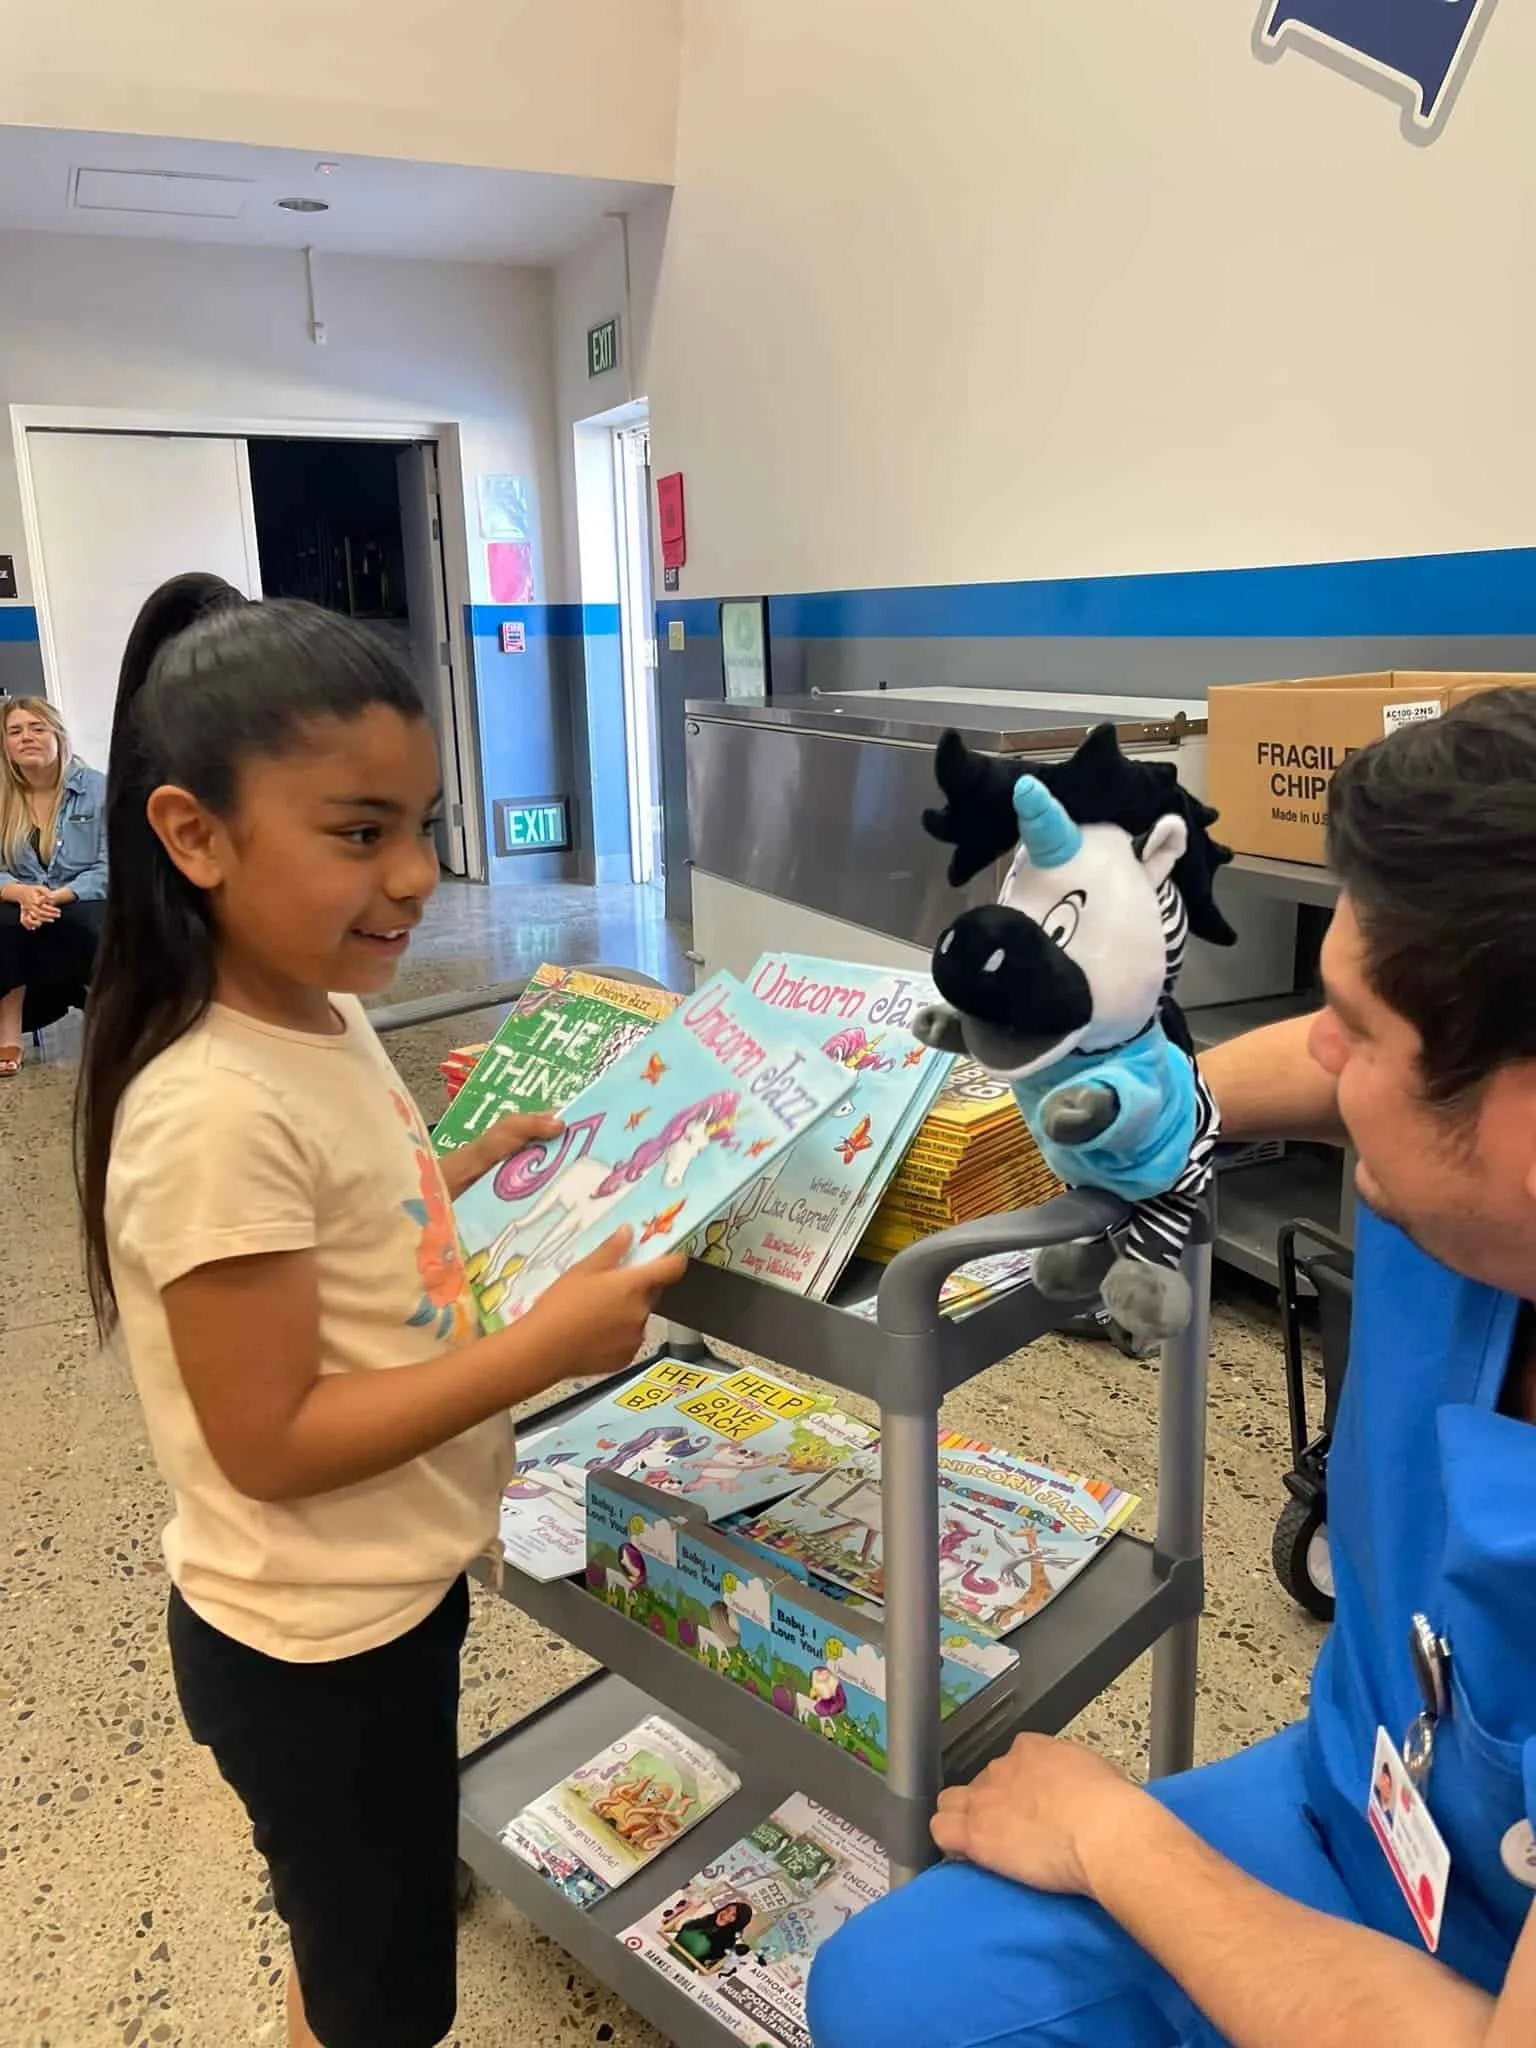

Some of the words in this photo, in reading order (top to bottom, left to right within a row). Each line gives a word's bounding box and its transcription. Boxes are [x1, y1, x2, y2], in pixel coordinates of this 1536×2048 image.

[593, 325, 612, 372] EXIT
[1258, 742, 1358, 770] FRAGIL
[1271, 773, 1327, 800] CHIP
[509, 808, 557, 845] EXIT
[1271, 807, 1297, 822] Made
[752, 961, 866, 1018] Unicorn
[868, 980, 929, 1031] Ja
[527, 1009, 600, 1061] THE
[683, 983, 767, 1078] Unicorn
[750, 1050, 820, 1131] Jazz
[760, 1191, 784, 1220] Lisa
[711, 1397, 762, 1425] GIVE
[731, 1376, 803, 1411] HELP
[687, 1402, 750, 1437] BACK
[940, 1457, 1040, 1497] NICORN
[1035, 1486, 1099, 1534] JAZZ
[940, 1475, 1018, 1513] OLORING
[1015, 1503, 1066, 1534] BOOK
[771, 1621, 796, 1645] Love
[800, 1638, 823, 1661] You!
[720, 1984, 746, 2004] MUSIC
[741, 1988, 771, 2012] BOOKS
[750, 1968, 784, 1993] AUTHOR
[784, 1990, 802, 2008] LISA
[697, 1990, 741, 2029] Walmart
